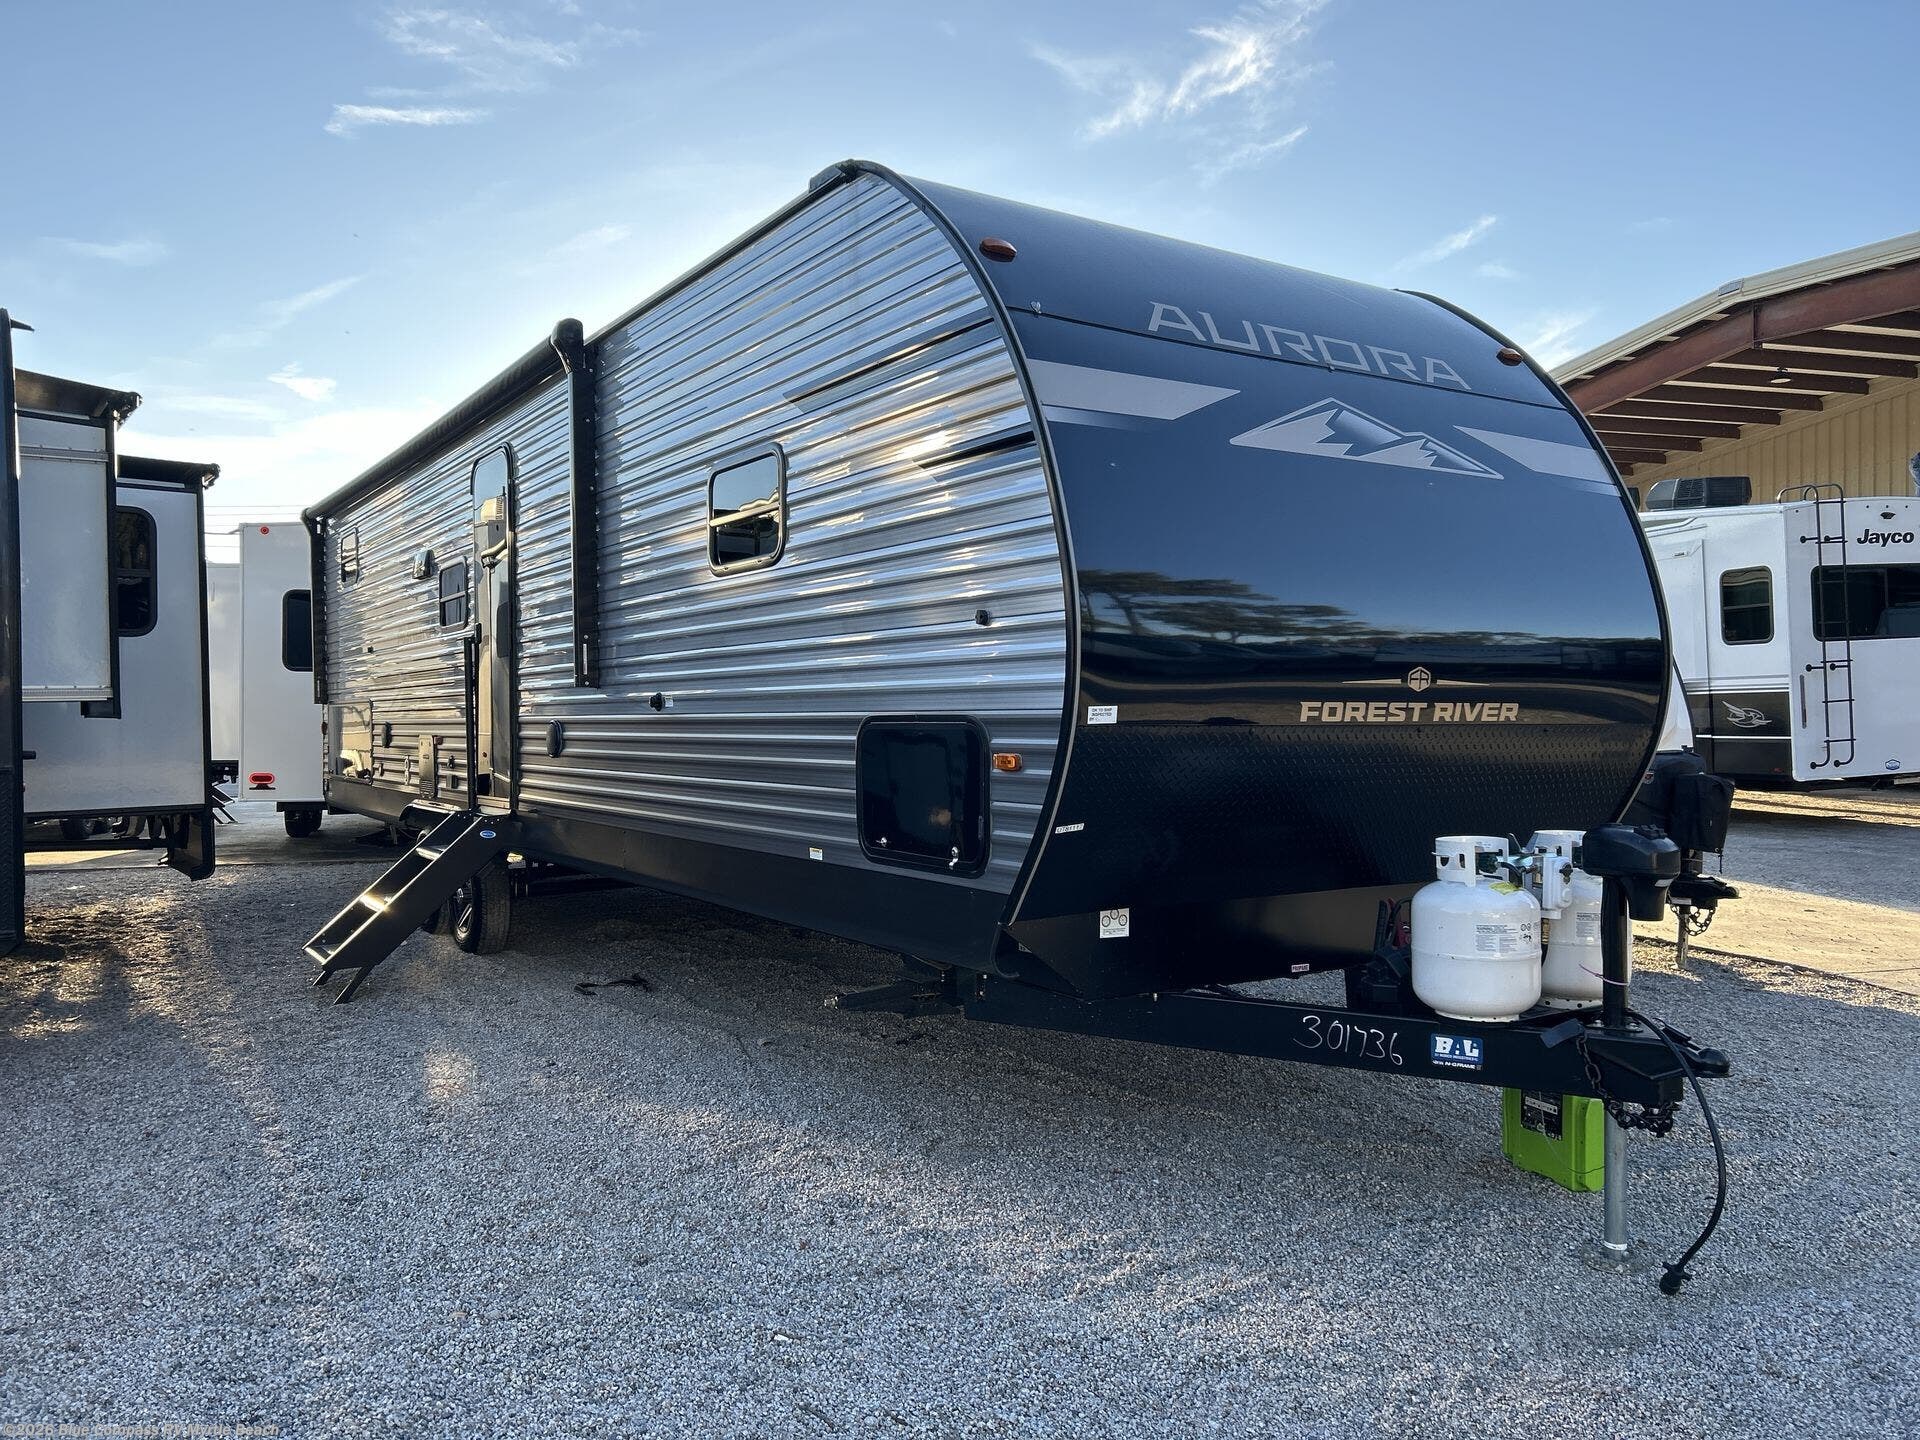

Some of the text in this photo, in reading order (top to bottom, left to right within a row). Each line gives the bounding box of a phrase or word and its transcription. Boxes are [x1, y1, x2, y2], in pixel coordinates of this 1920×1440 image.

[1147, 301, 1472, 391] AURORA
[1856, 528, 1915, 548] Jayco
[1300, 701, 1520, 723] FOREST RIVER
[1293, 1015, 1403, 1066] 301736
[1435, 1036, 1480, 1058] BAL
